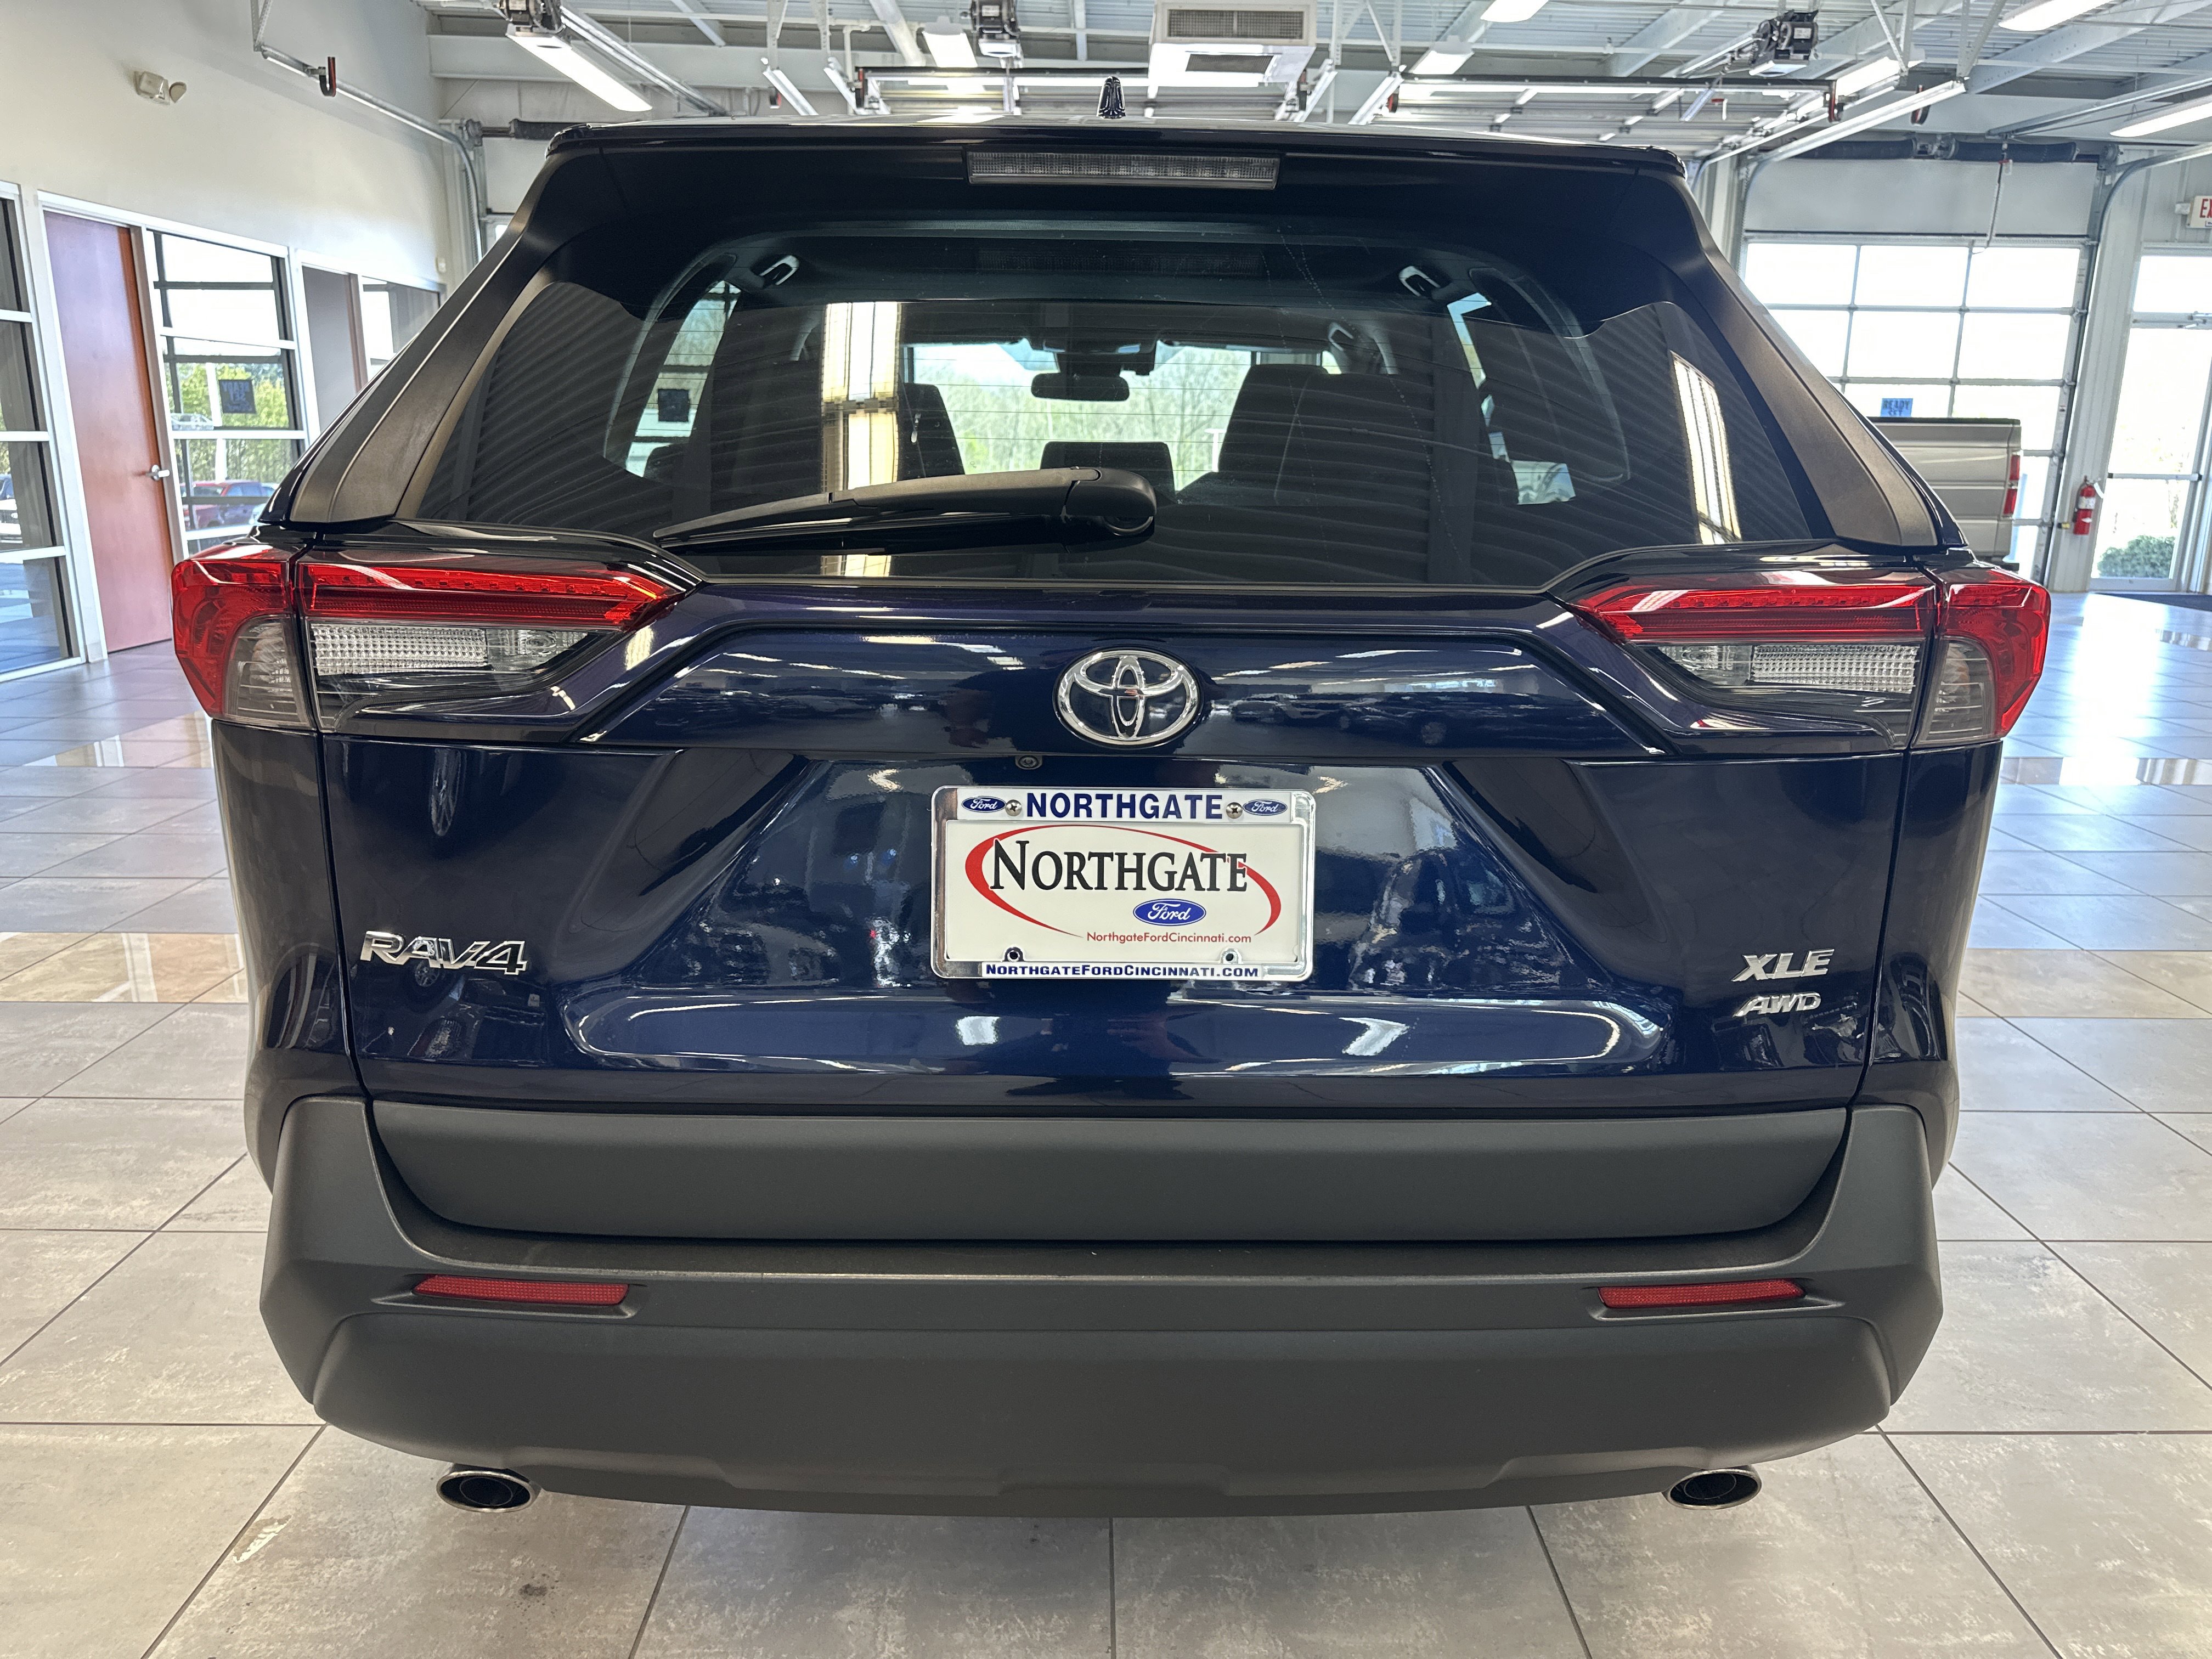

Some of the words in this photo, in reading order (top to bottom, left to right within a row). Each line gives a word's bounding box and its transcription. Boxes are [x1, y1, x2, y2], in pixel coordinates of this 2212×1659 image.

[1883, 400, 1910, 409] READY
[970, 798, 998, 810] Ford
[1027, 792, 1222, 819] NORTHGATE
[1251, 800, 1279, 812] Ford
[990, 839, 1248, 892] NORTHGATE
[1147, 902, 1192, 921] Ford
[1087, 932, 1251, 944] NorthgateFordCincinnati.com
[360, 930, 527, 975] RAV4
[1730, 948, 1835, 982] XLE
[986, 963, 1259, 978] NORTHGATEFORDCINCINNATI.COM
[1733, 991, 1821, 1018] AWD
